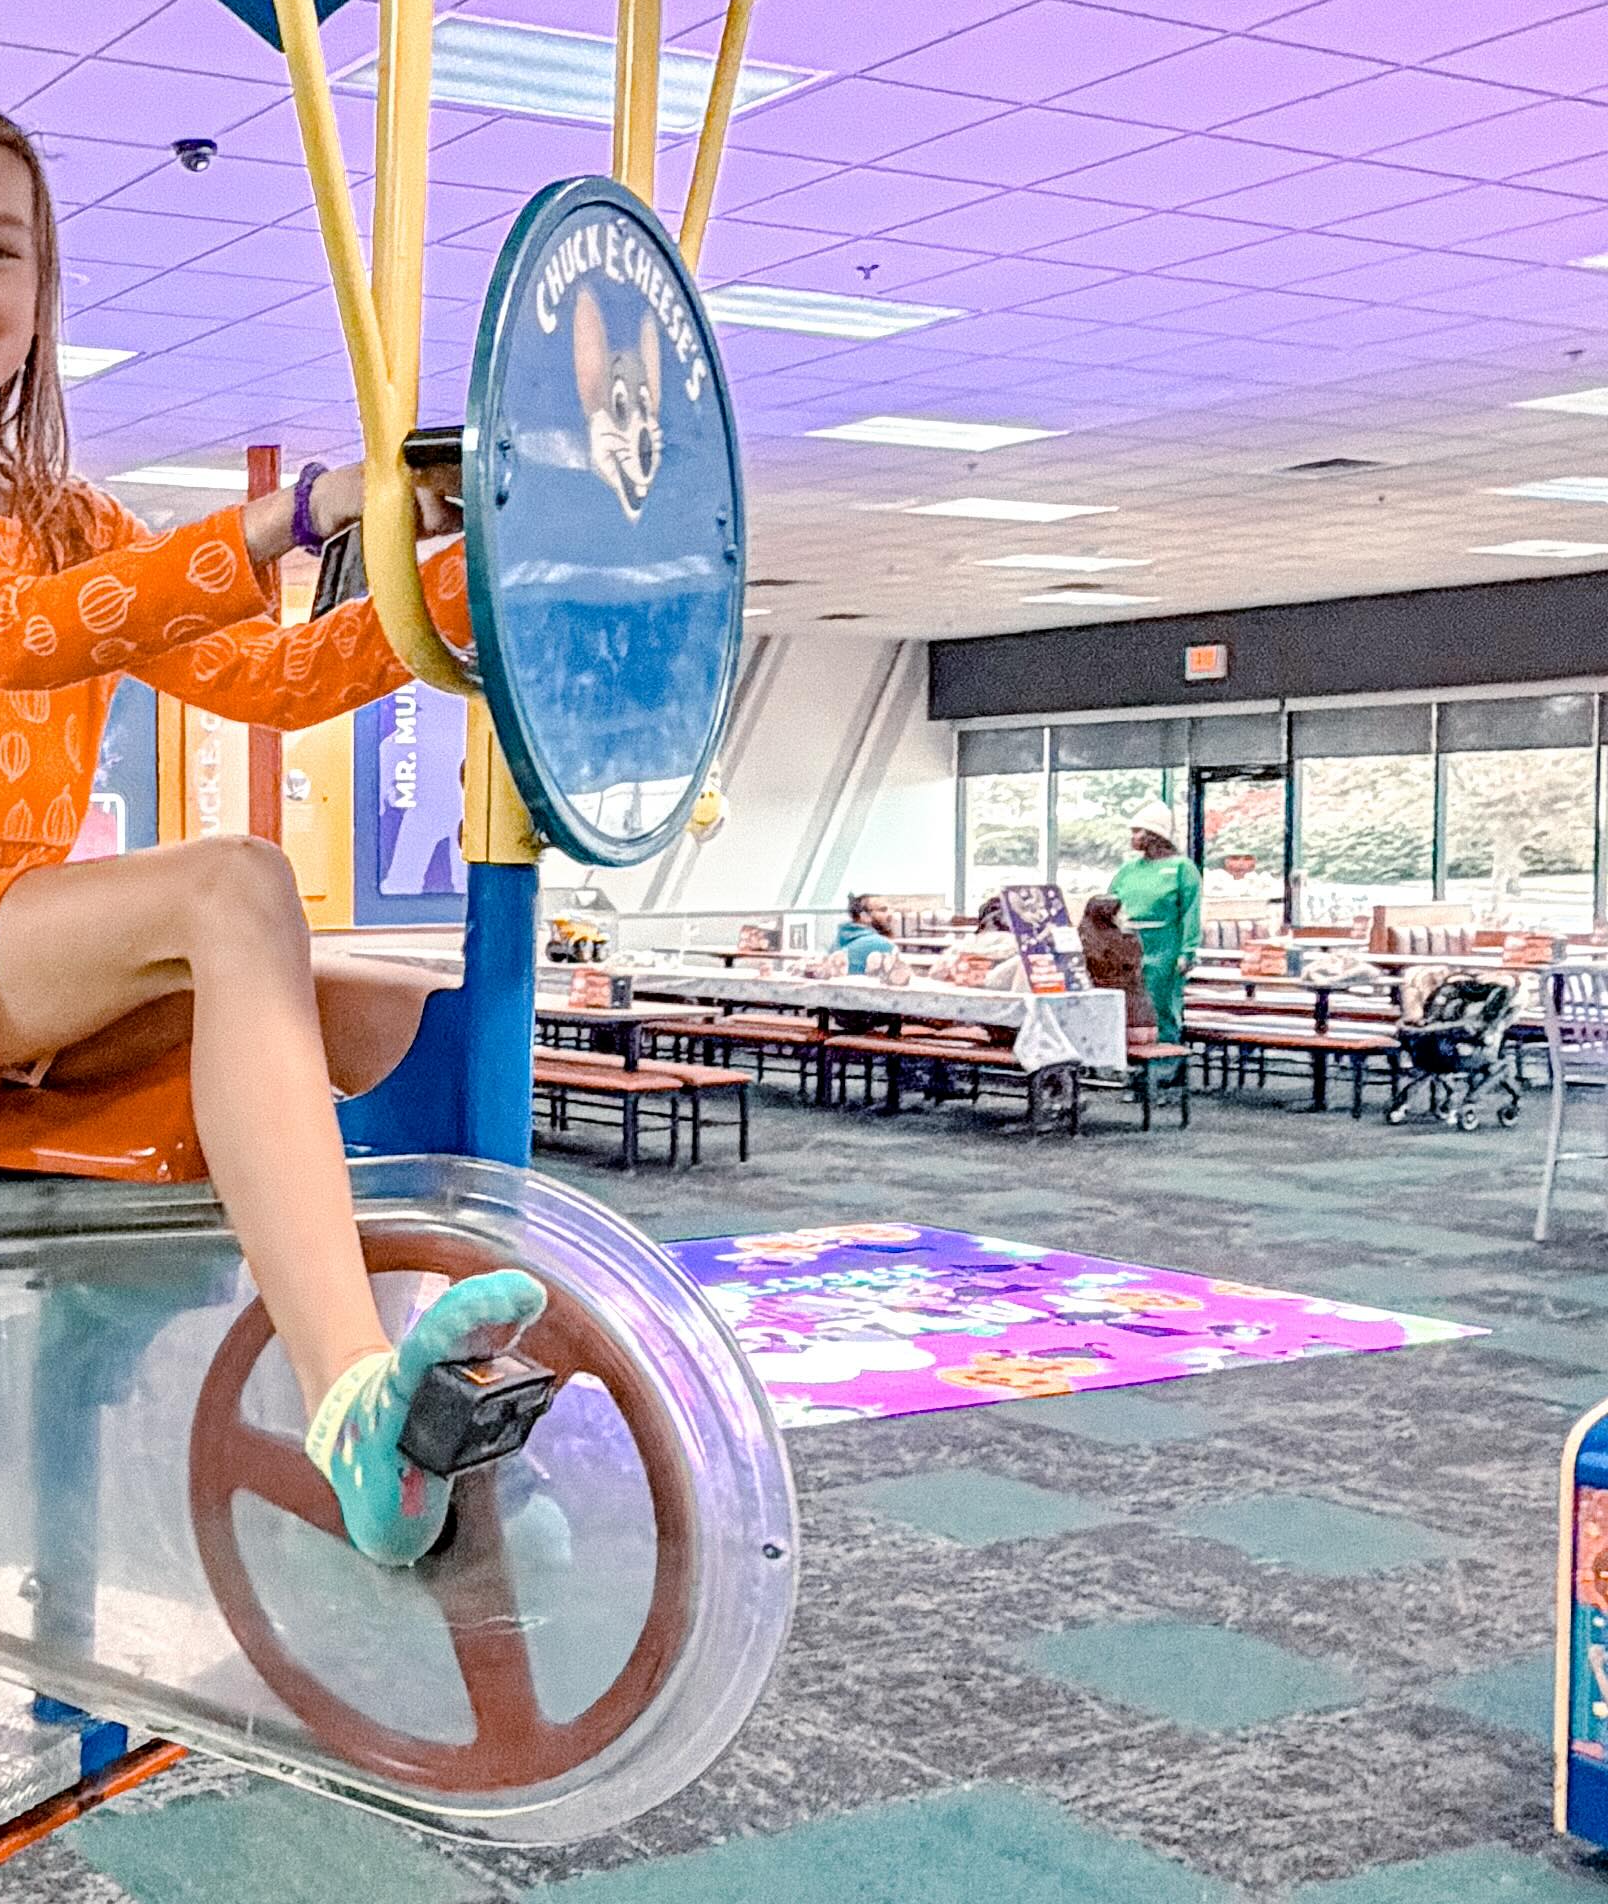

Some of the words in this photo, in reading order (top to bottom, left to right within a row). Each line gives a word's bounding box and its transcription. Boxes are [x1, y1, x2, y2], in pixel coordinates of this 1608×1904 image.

[536, 224, 602, 334] CHUCK
[623, 237, 707, 401] CHEESE'S
[198, 768, 221, 837] UCK
[394, 751, 417, 808] MR.
